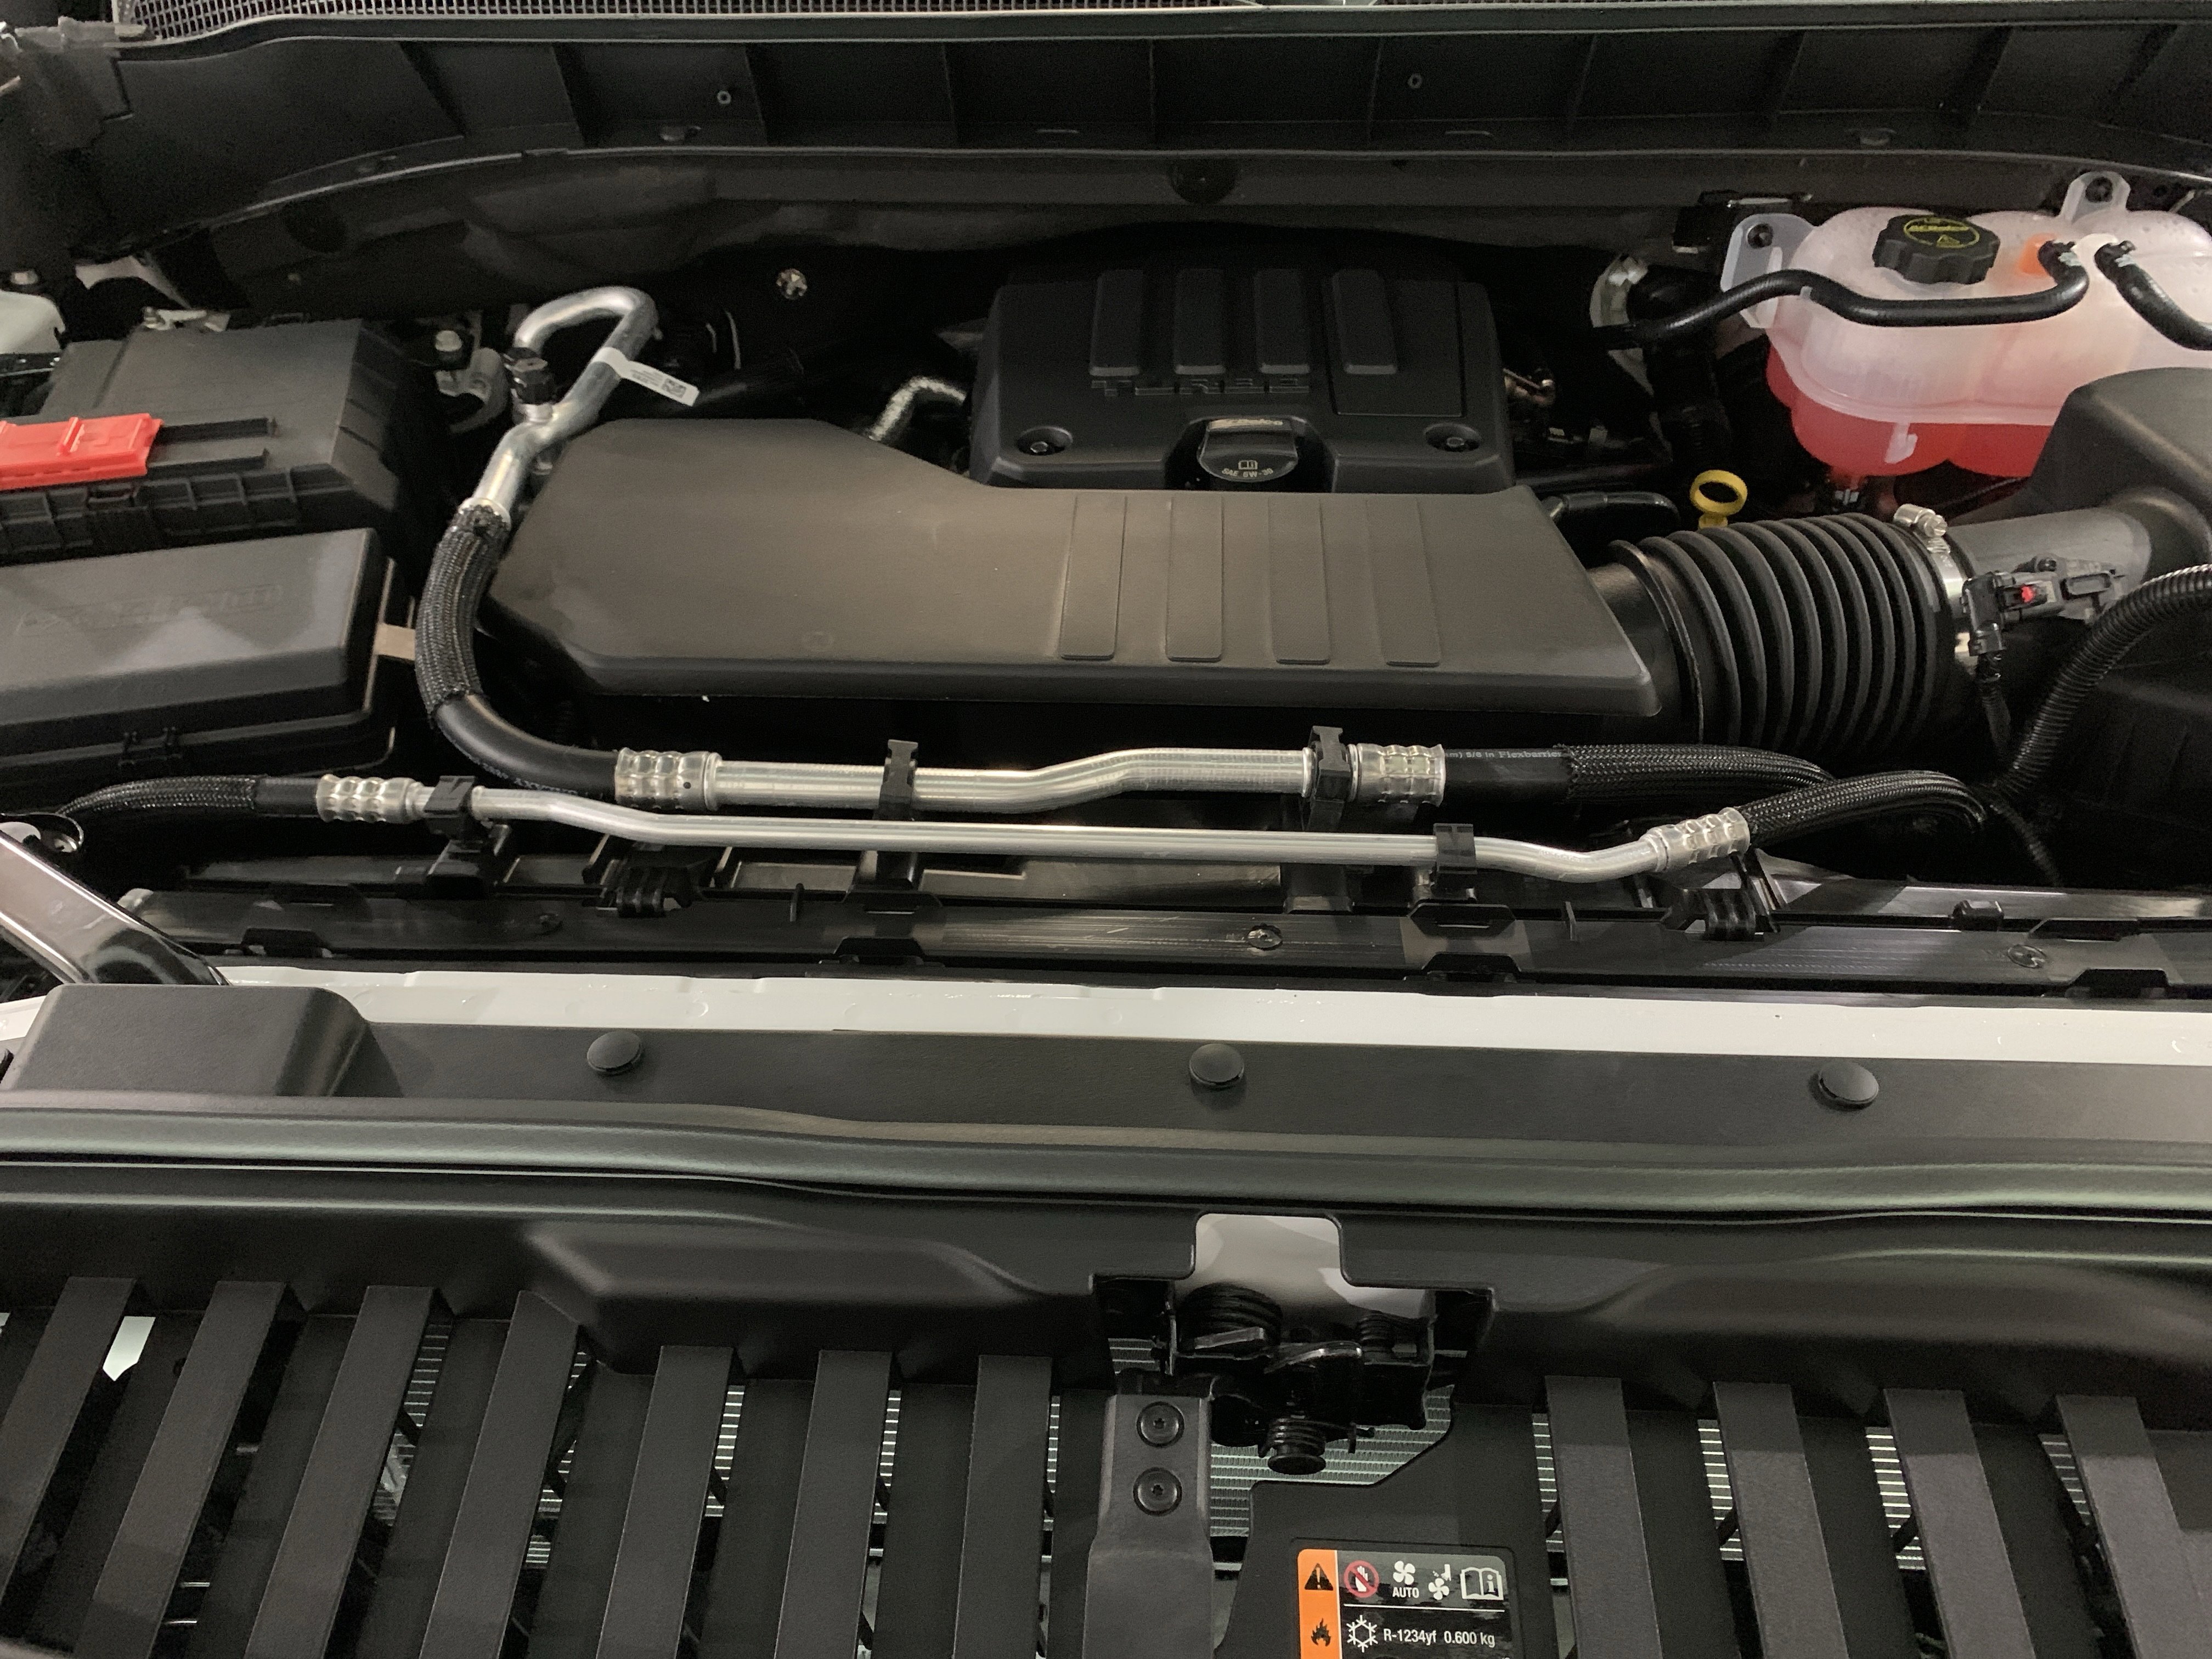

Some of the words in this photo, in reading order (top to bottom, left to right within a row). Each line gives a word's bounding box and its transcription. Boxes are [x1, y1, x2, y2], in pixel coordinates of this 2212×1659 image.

[1221, 468, 1239, 476] SAE
[1392, 1587, 1420, 1598] AUTO
[1383, 1628, 1437, 1646] R-1234yf
[1443, 1630, 1477, 1645] 0.600
[1480, 1632, 1496, 1648] kg
